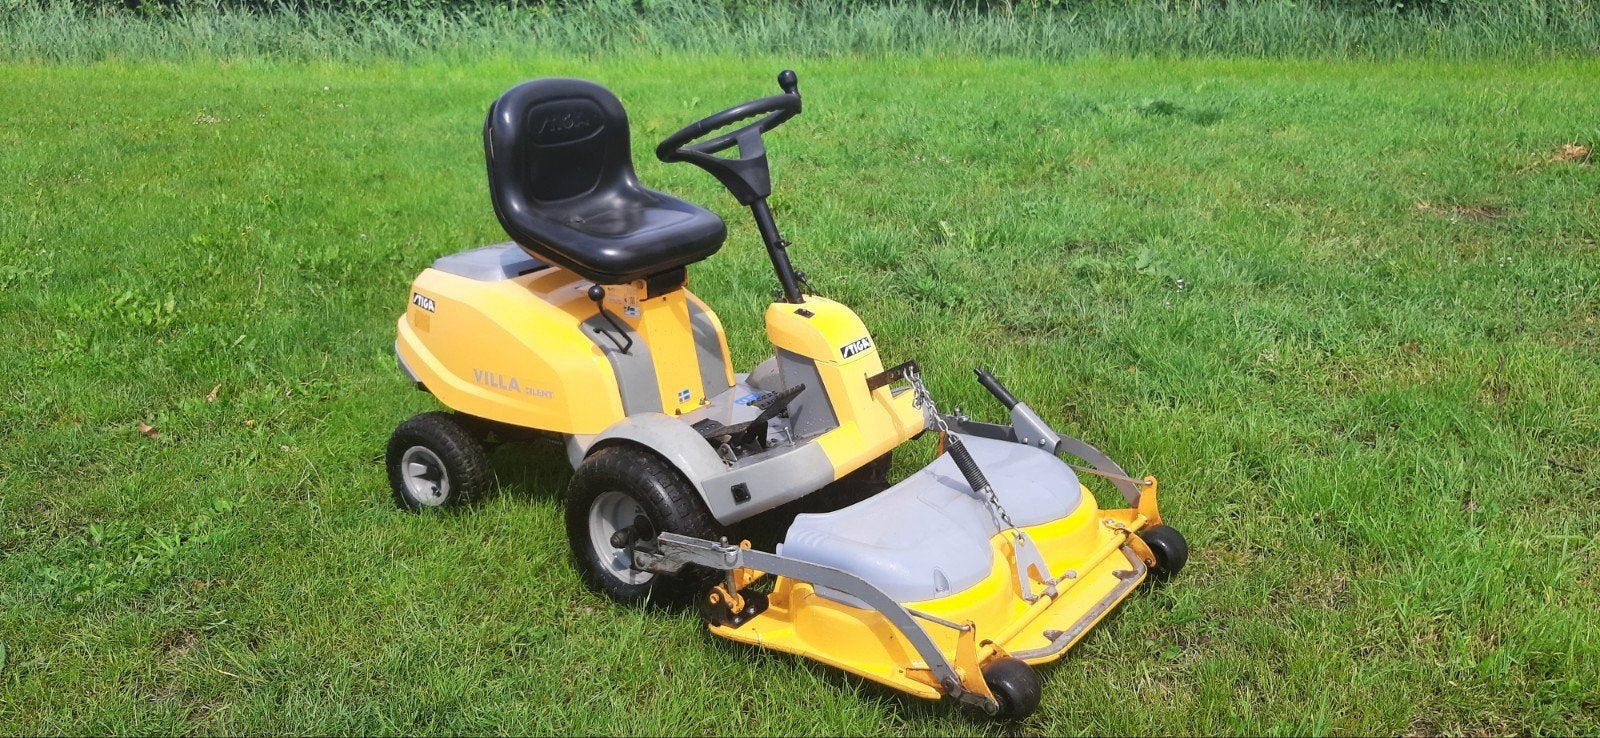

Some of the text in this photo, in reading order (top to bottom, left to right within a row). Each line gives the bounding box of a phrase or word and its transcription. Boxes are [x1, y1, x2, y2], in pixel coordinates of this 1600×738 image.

[413, 293, 435, 312] STIGA
[842, 337, 871, 358] STIGA
[473, 368, 554, 399] VILLA SILENT
